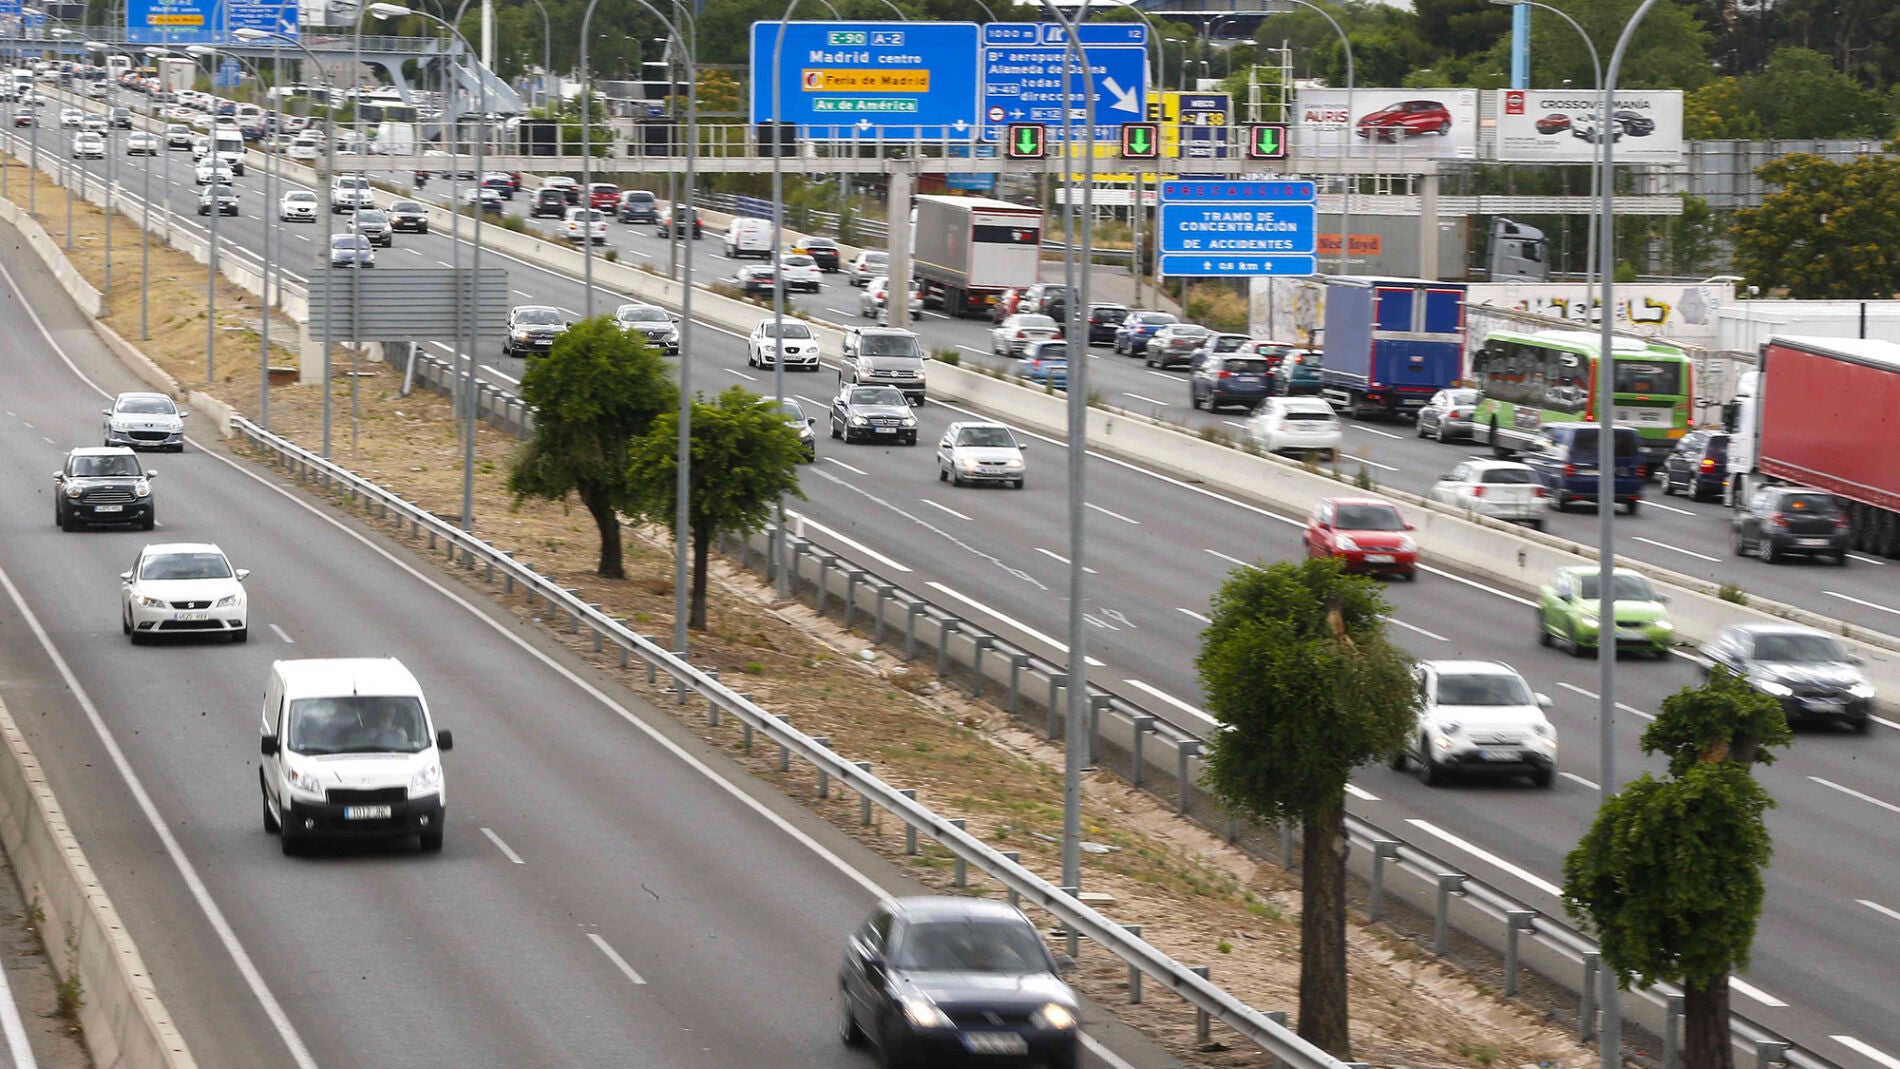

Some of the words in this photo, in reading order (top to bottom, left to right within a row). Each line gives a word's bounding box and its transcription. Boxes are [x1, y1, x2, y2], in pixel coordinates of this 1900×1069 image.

[829, 33, 865, 44] E-90
[874, 33, 902, 44] A-2
[1128, 30, 1142, 38] 12
[809, 50, 869, 63] Madrid
[878, 55, 922, 63] centro
[988, 65, 1043, 74] Alameda
[1047, 65, 1063, 74] de
[825, 75, 857, 85] Feria
[862, 77, 876, 85] de
[881, 75, 926, 85] Madrid
[1021, 78, 1061, 87] todas
[838, 101, 853, 109] de
[856, 100, 915, 110] América
[1207, 112, 1225, 126] 38
[1304, 111, 1349, 123] AURIS
[1202, 212, 1252, 221] TRAMO
[1257, 212, 1275, 221] DE
[1179, 221, 1298, 232] CONCENTRACIÓN
[1183, 240, 1200, 249] DE
[1209, 240, 1294, 249] ACCIDENTES
[1238, 261, 1259, 271] km
